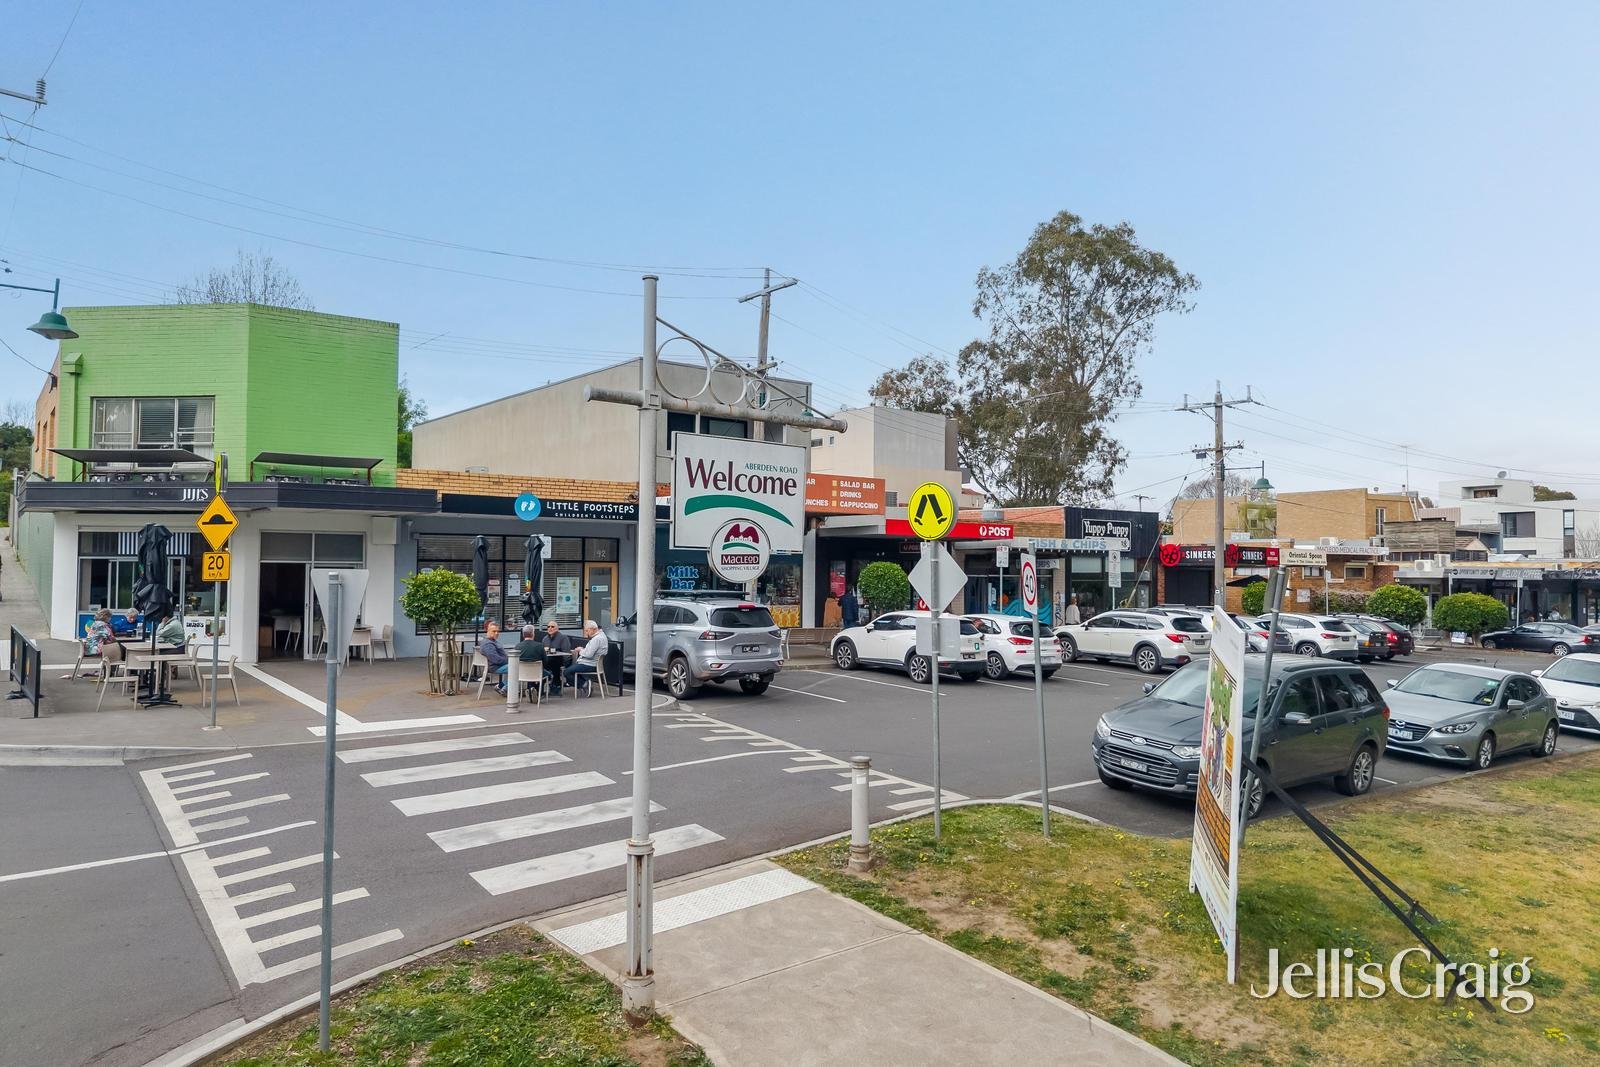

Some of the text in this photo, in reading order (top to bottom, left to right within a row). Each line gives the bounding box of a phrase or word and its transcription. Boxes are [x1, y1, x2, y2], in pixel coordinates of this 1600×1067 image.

[744, 462, 798, 475] ABERDEEN ROAD
[684, 456, 797, 497] Welcome
[806, 478, 816, 486] AR
[839, 480, 876, 490] SALAD BAR
[839, 490, 862, 499] DRINKS
[546, 501, 635, 514] LITTLE FOOTSTEPS
[804, 498, 829, 507] UNCHES
[839, 500, 879, 510] CAPPUCCINO
[988, 527, 1011, 537] POST
[1083, 520, 1129, 538] Yuppy Puppy
[1035, 539, 1107, 550] ISH & CHIPS
[1185, 550, 1216, 559] SINNERS
[1242, 550, 1263, 560] SINNERS
[1288, 551, 1308, 559] Oriental
[207, 555, 225, 570] 20
[667, 565, 699, 579] Milk
[671, 578, 696, 590] Bar
[1024, 574, 1035, 594] 40
